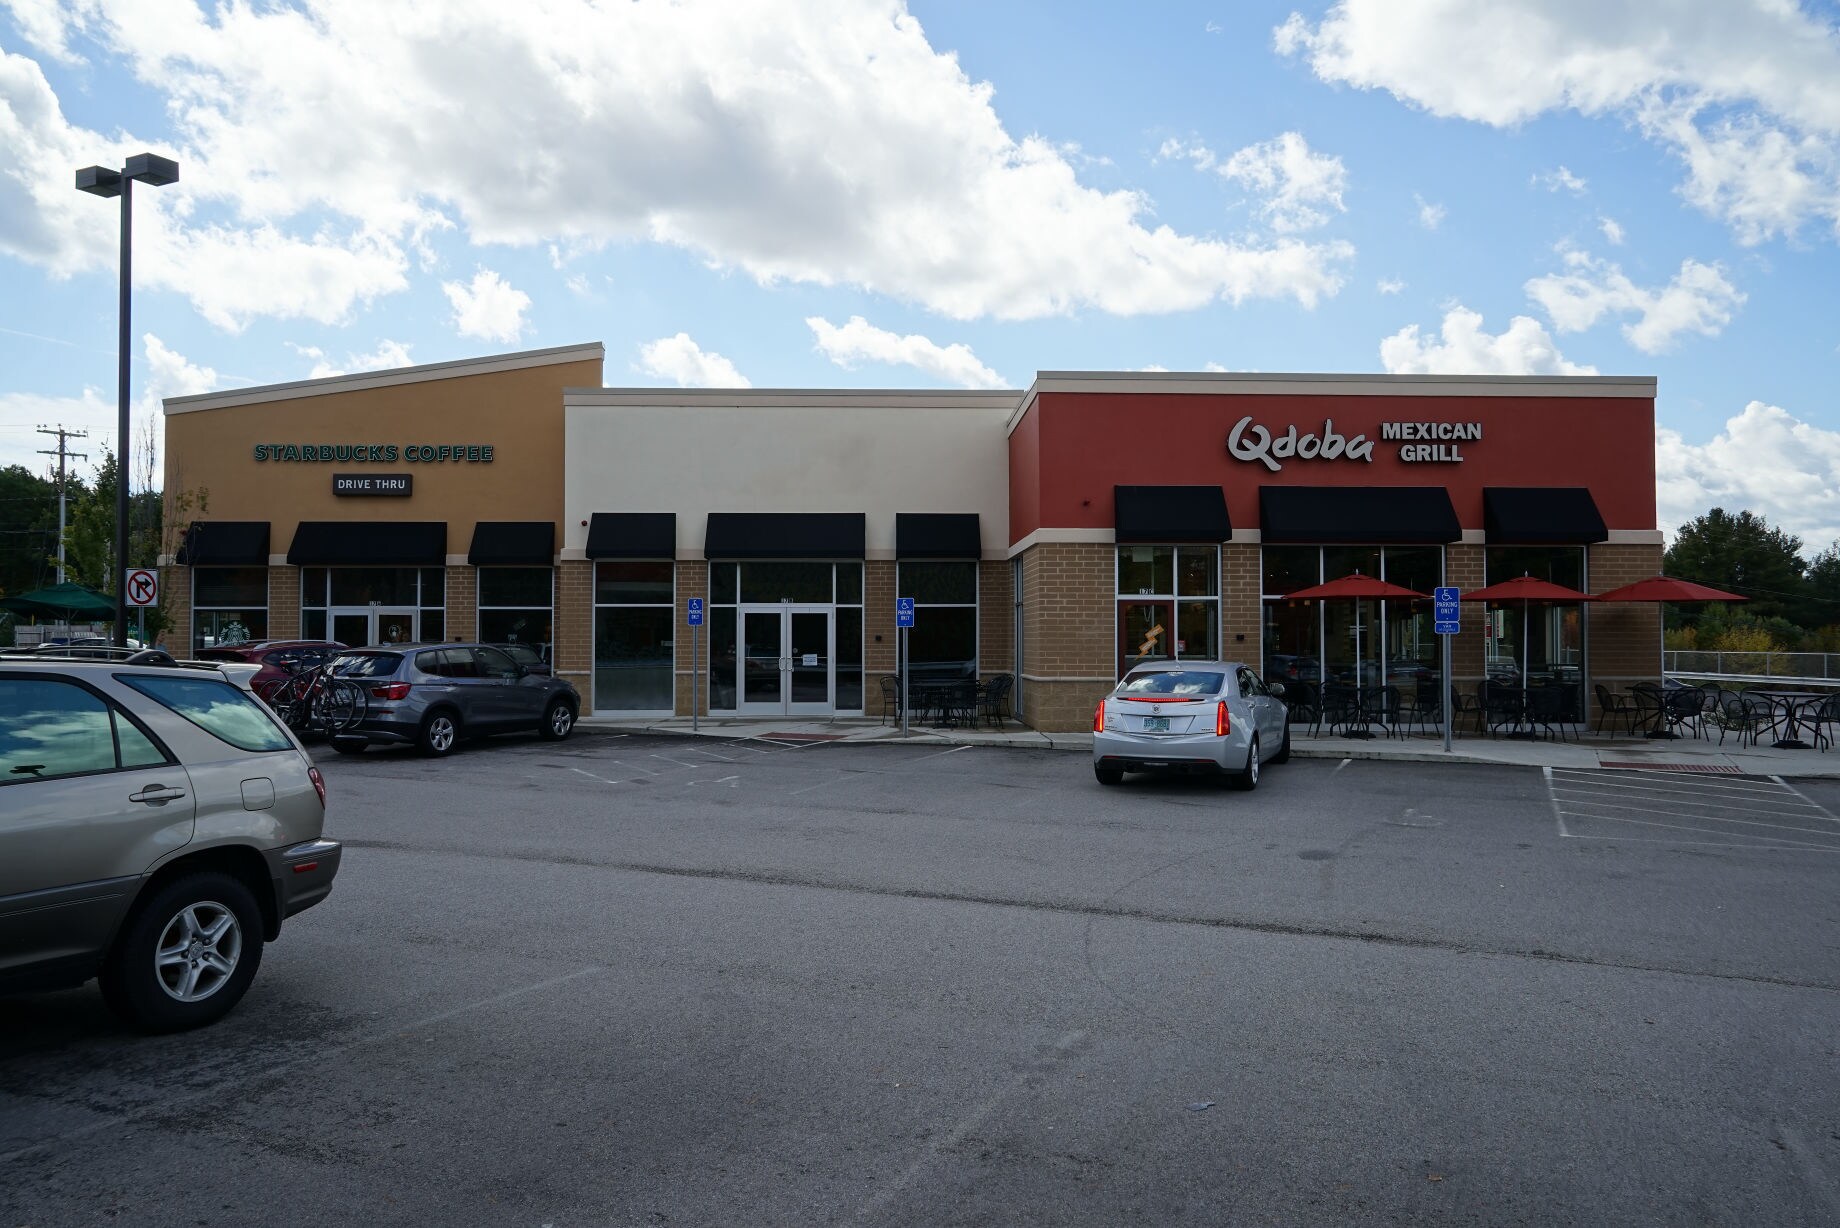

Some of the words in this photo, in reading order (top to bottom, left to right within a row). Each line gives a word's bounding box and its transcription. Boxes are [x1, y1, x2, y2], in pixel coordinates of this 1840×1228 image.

[1381, 422, 1482, 441] MEXICAN
[254, 443, 399, 463] STARBUCKS
[403, 444, 494, 463] COFFEE
[1227, 416, 1374, 472] Qdoba
[1400, 444, 1464, 462] GRILL
[337, 479, 371, 489] DRIVE
[375, 479, 406, 489] THRU
